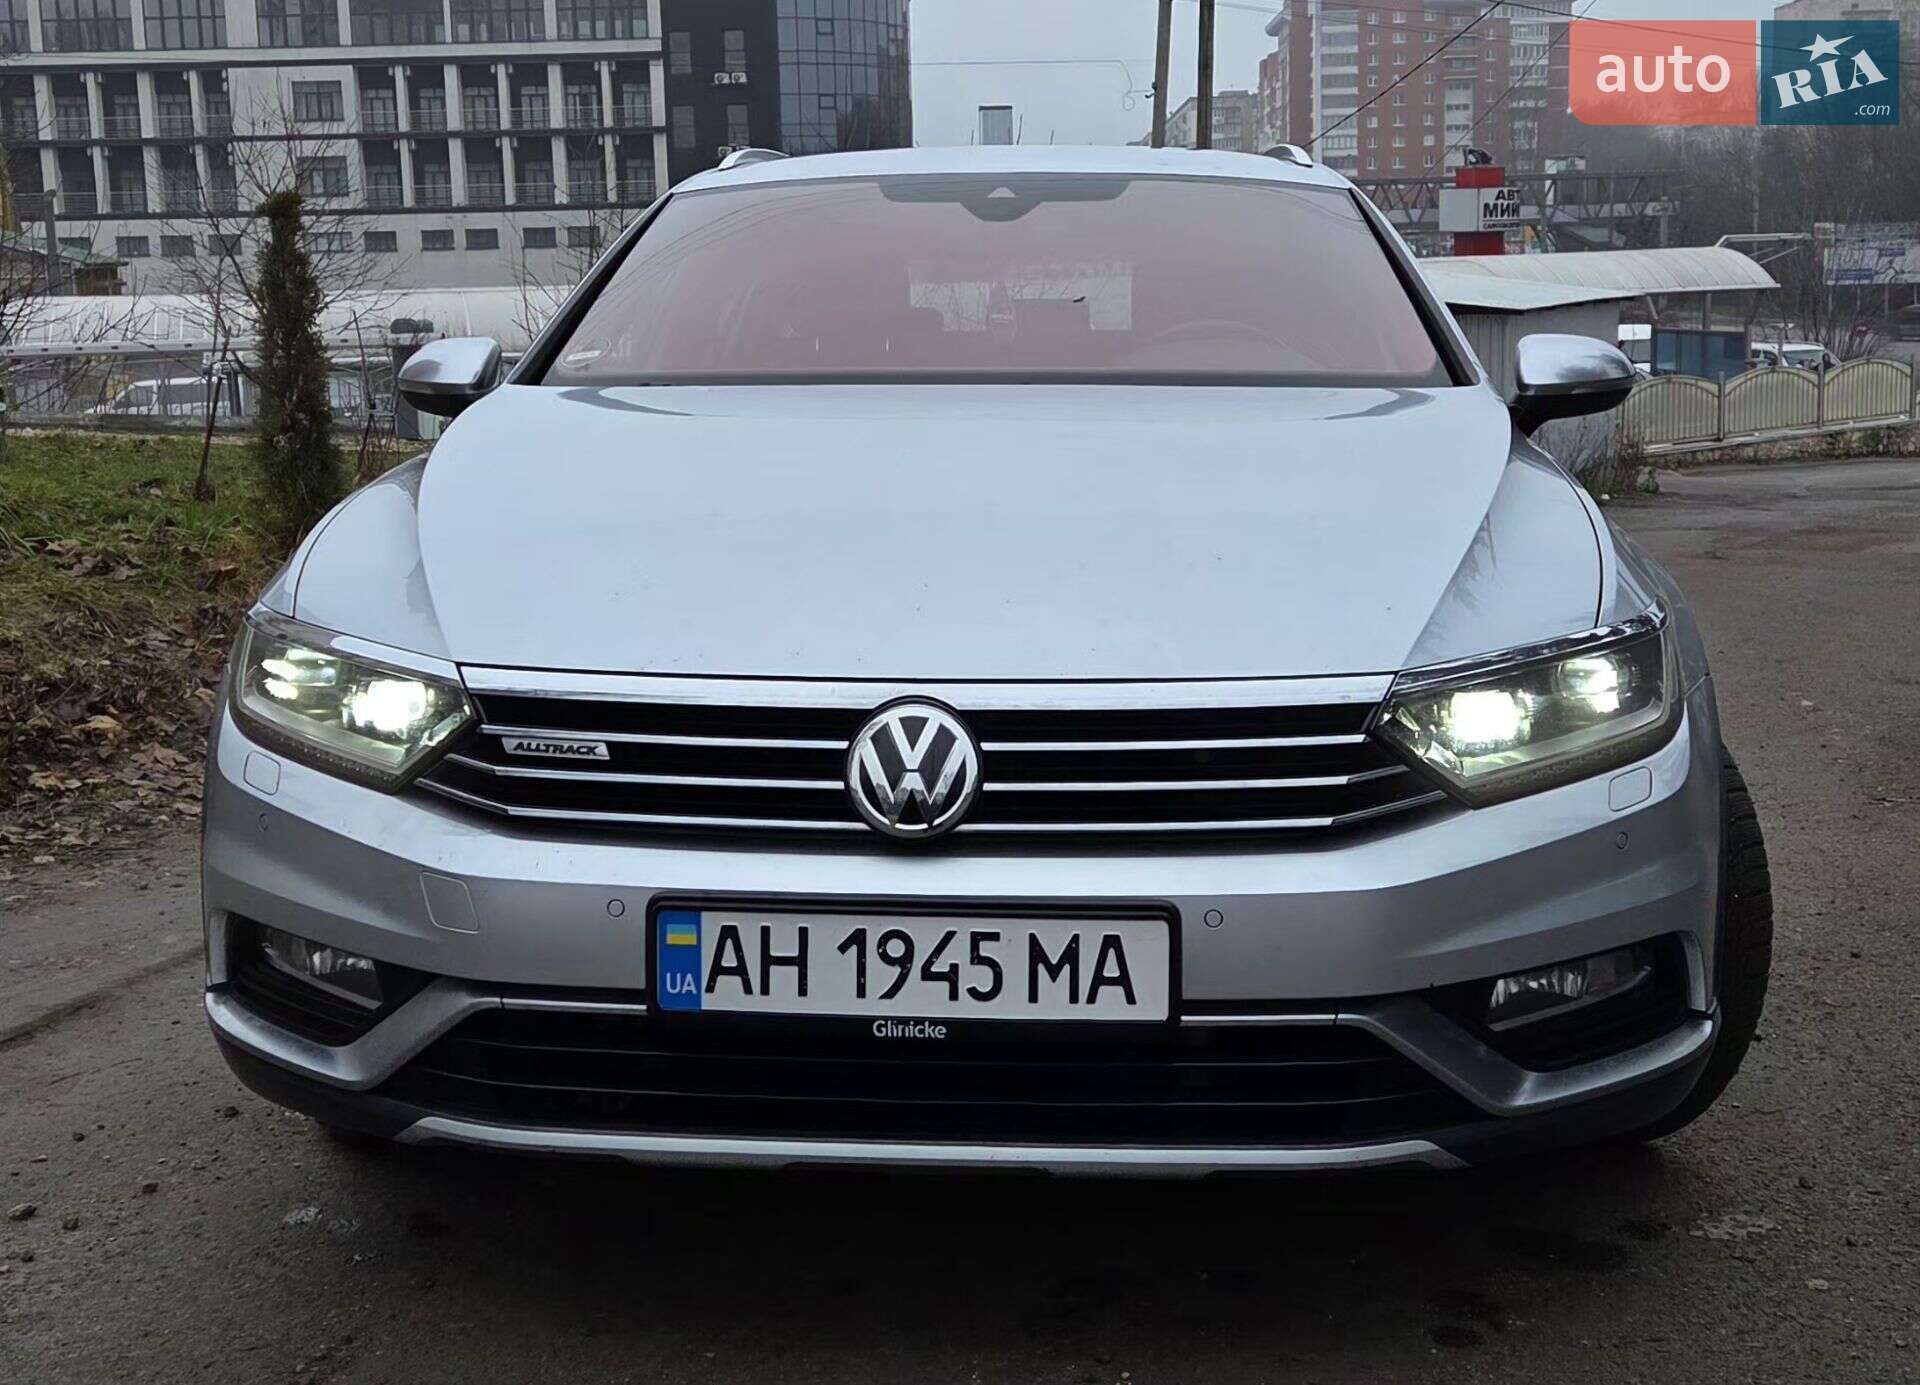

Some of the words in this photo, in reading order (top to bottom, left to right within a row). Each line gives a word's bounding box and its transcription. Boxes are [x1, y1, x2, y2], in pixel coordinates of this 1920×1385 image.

[513, 741, 599, 756] ALLTRACK
[705, 924, 809, 997] AH
[837, 928, 1004, 1002] 1945
[1028, 932, 1137, 1005] MA
[666, 972, 697, 994] UA
